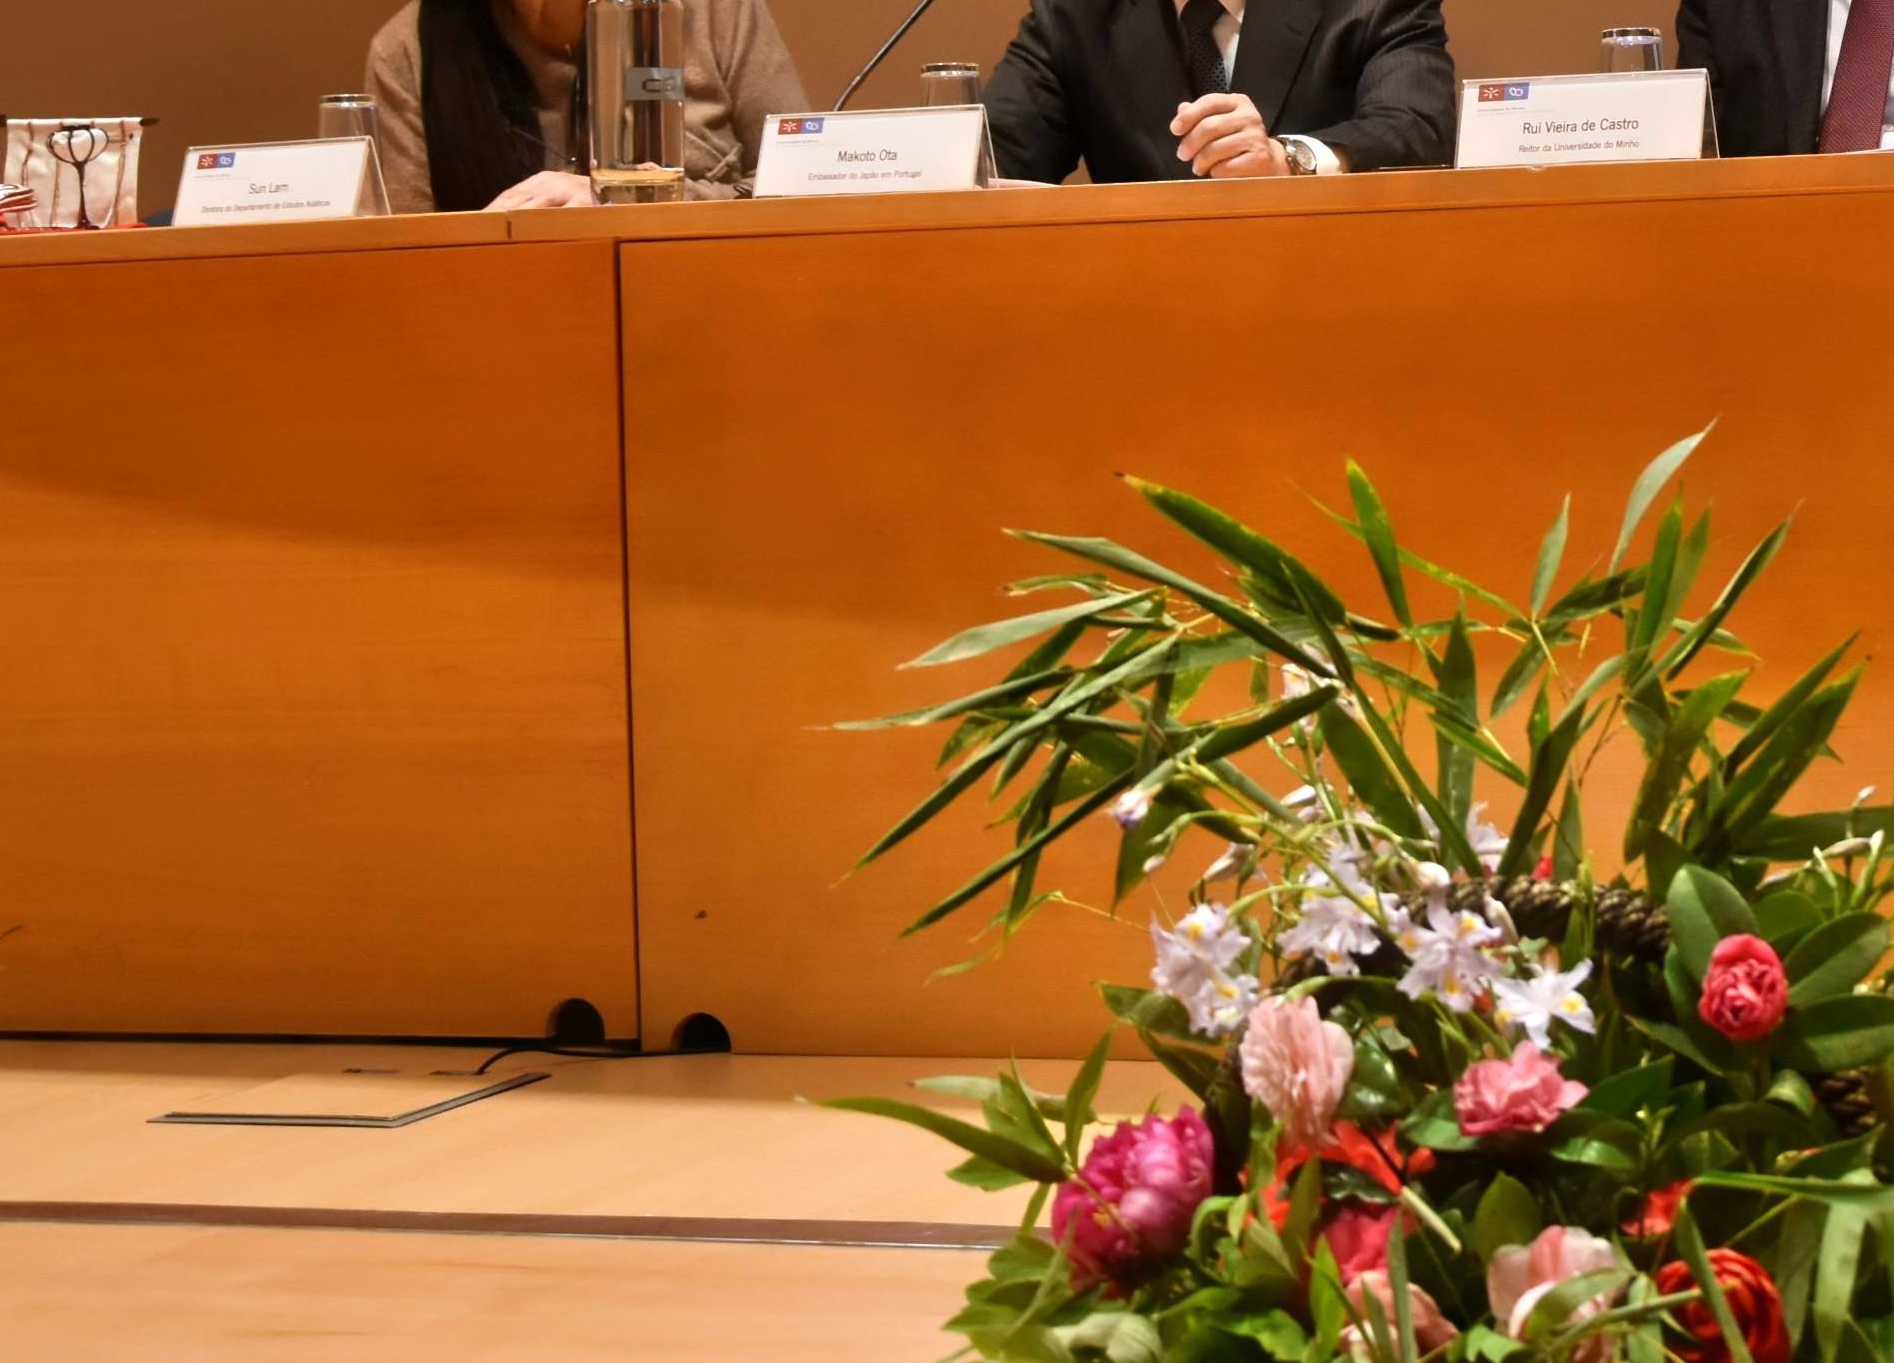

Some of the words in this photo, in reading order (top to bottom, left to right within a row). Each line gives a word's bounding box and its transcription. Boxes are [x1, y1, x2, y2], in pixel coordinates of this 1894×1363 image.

[1522, 122, 1541, 135] Rui
[1546, 121, 1577, 134] Vieira
[1581, 120, 1596, 132] de
[1600, 118, 1639, 131] Castro
[1518, 144, 1540, 153] Reitor
[1542, 143, 1552, 152] da
[1554, 141, 1601, 151] Universidade
[1603, 141, 1614, 149] do
[1616, 140, 1640, 149] Minho
[837, 150, 875, 163] Makoto
[879, 149, 898, 161] Ota
[894, 170, 922, 180] Portugal
[248, 184, 266, 195] Sun
[269, 183, 289, 194] Lam
